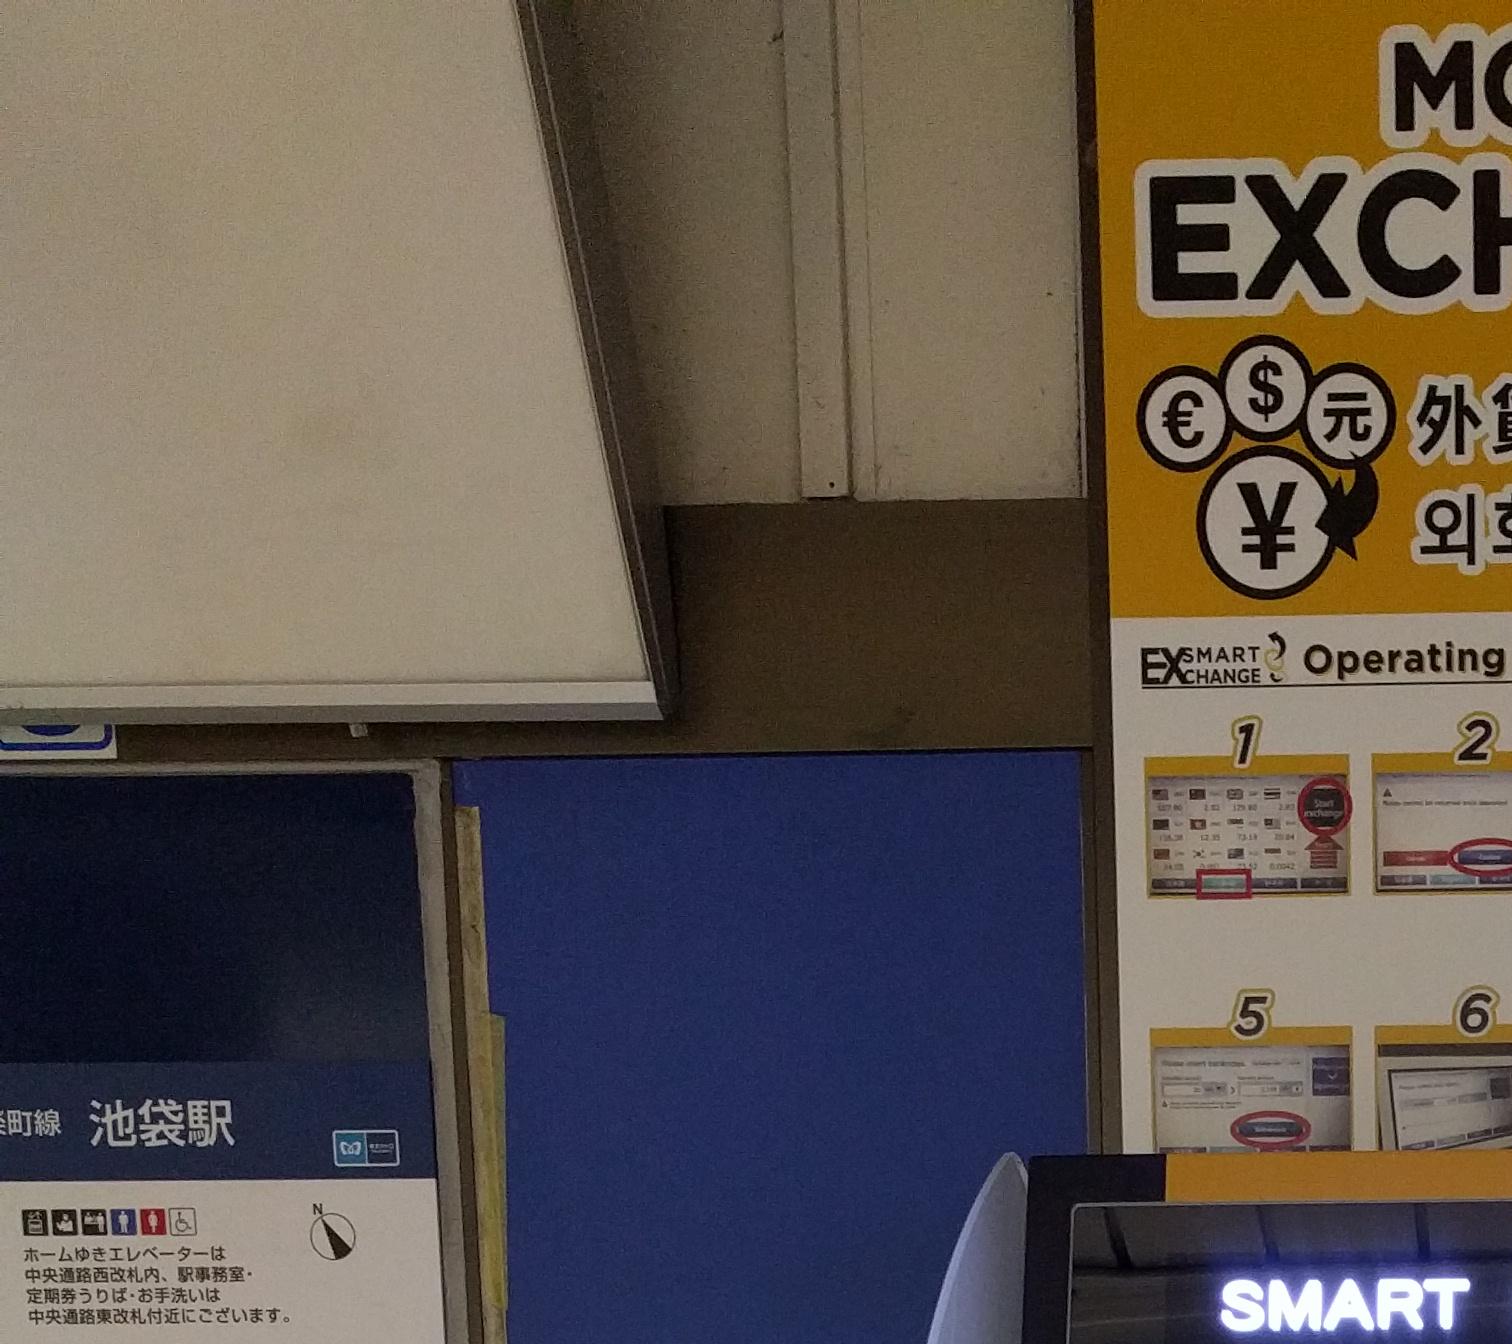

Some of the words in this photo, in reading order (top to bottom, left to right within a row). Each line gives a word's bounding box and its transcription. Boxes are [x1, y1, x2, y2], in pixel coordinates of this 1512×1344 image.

[1322, 391, 1374, 441] 元
[1182, 647, 1261, 664] SMART
[1303, 641, 1505, 678] Operating
[1237, 721, 1258, 765] 1
[1457, 717, 1494, 761] 2
[1233, 995, 1269, 1038] 5
[1459, 992, 1493, 1034] 6
[89, 1098, 236, 1148] 池袋駅
[312, 1203, 324, 1215] N
[24, 1246, 227, 1263] ホームゆきエレベーターは
[28, 1307, 292, 1326] 中央通路東改札付近にございます。
[1218, 1277, 1471, 1333] SMART
